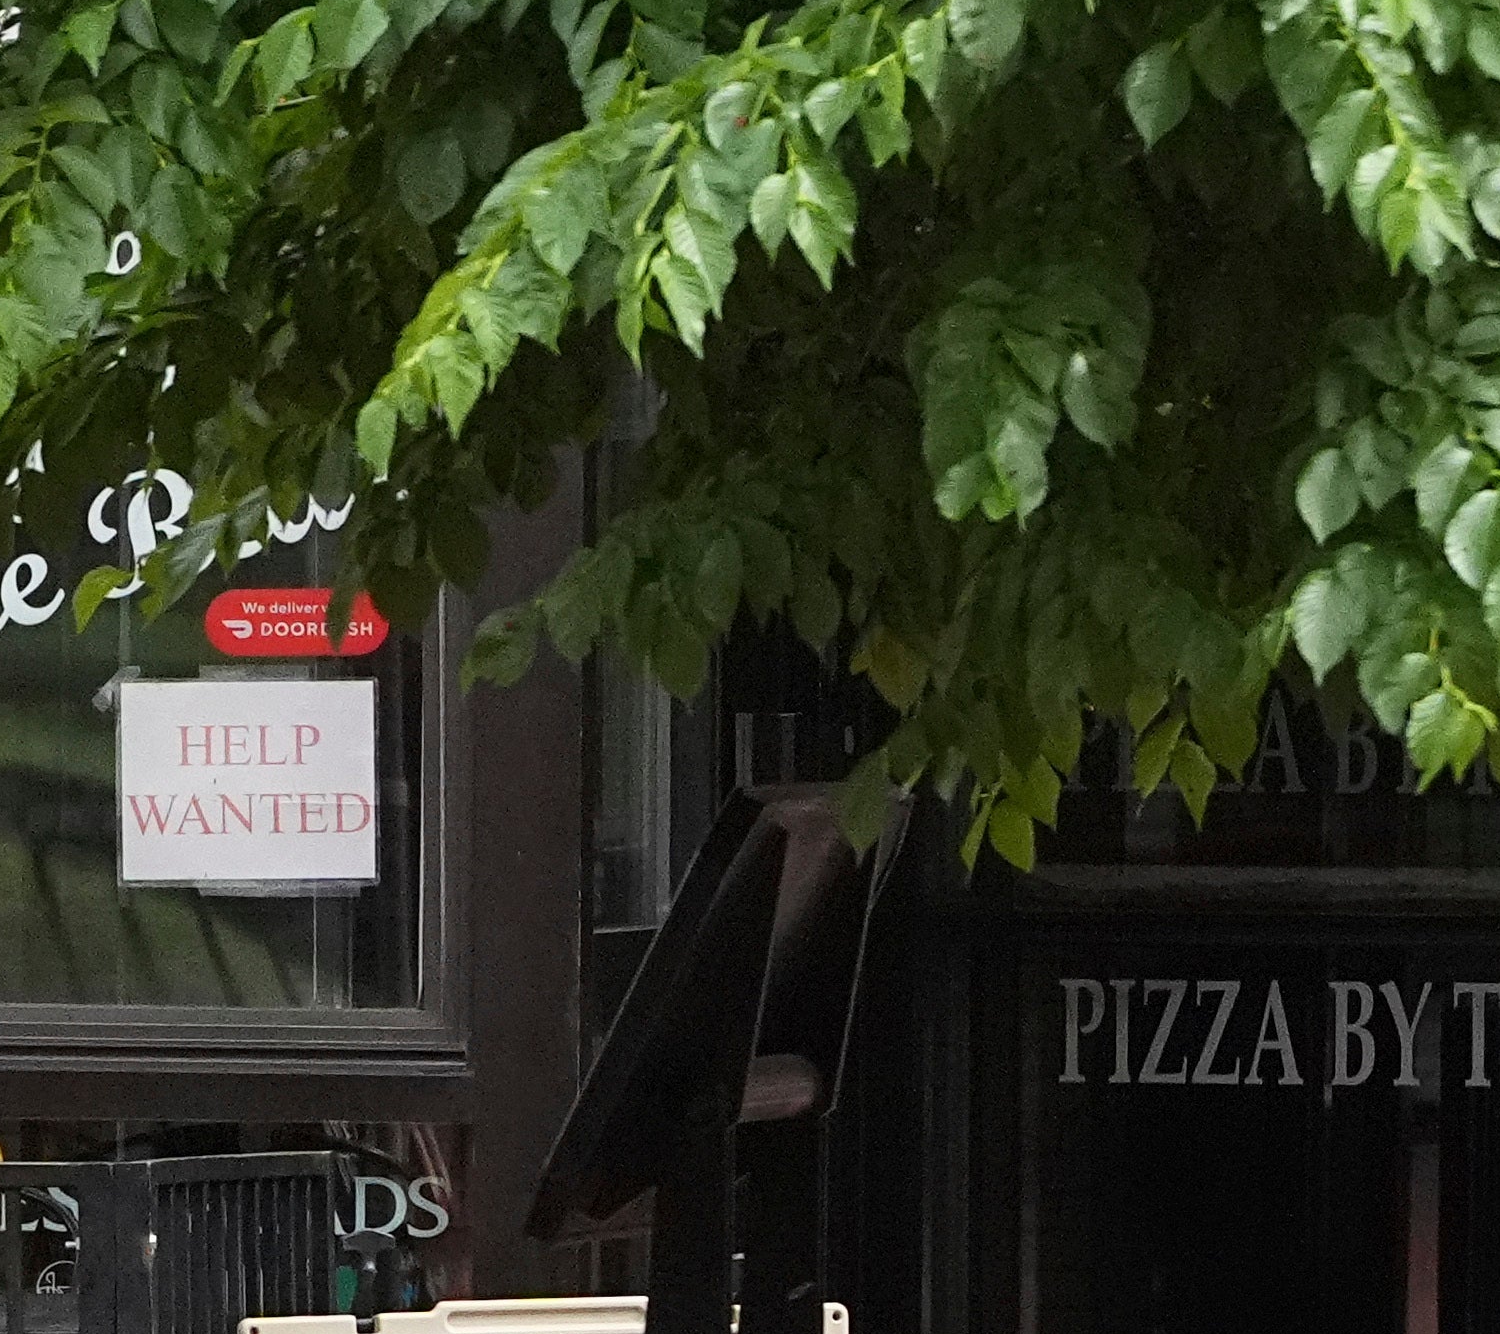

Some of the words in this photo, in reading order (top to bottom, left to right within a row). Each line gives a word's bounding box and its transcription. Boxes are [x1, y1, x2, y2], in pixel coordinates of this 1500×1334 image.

[241, 602, 266, 614] We
[270, 601, 319, 614] deliver
[177, 724, 321, 766] HELP
[127, 792, 371, 836] WANTED
[1058, 978, 1304, 1086] PIZZA
[1327, 979, 1433, 1087] BY
